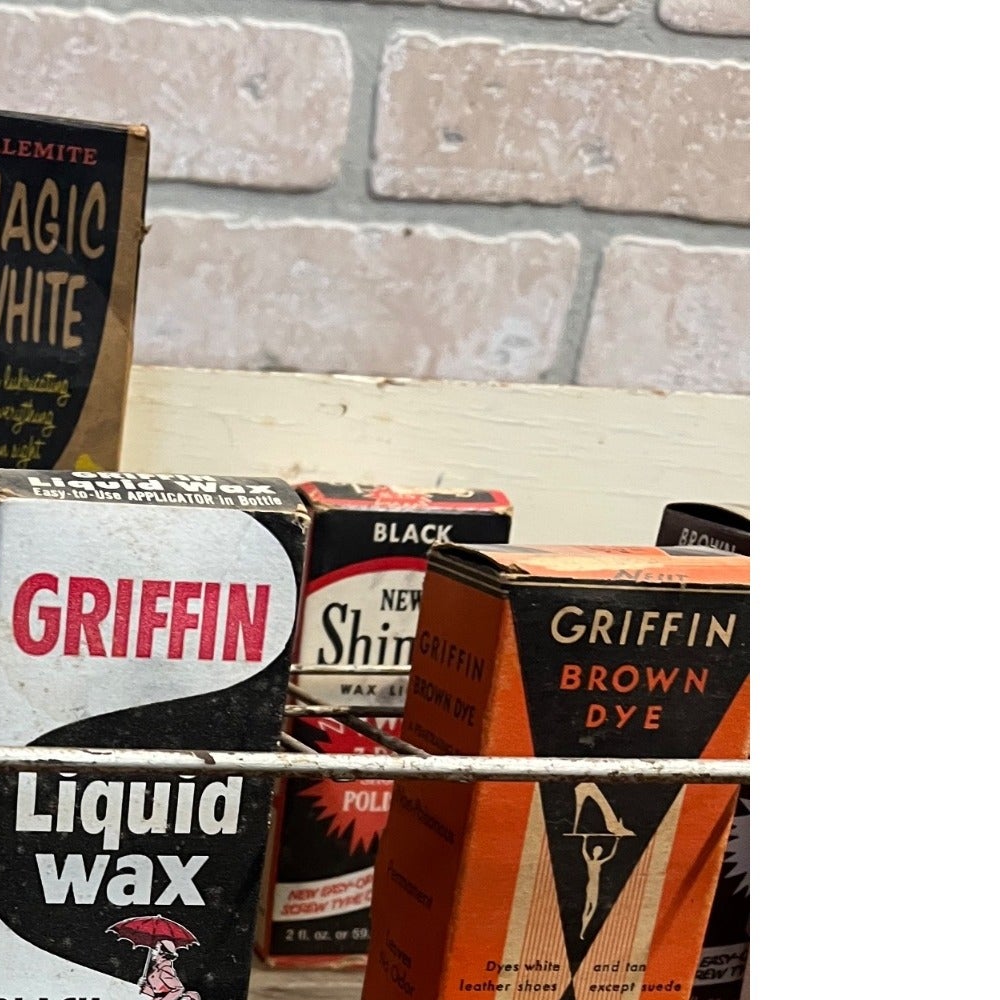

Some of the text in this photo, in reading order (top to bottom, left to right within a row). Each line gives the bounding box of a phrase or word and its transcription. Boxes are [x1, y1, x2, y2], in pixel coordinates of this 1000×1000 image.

[27, 476, 277, 495] Liquid Wax
[32, 487, 283, 507] Easy-to-Use APPLICATOR in Bottle
[372, 522, 453, 545] BLACK
[13, 572, 271, 662] GRIFFIN
[550, 605, 737, 648] GRIFFIN
[419, 630, 485, 682] GRIFFIN
[340, 684, 377, 695] WAX
[559, 664, 710, 693] BROWN
[412, 675, 476, 727] BROWN DYE
[585, 704, 663, 729] DYE
[15, 772, 243, 851] Liquid
[35, 853, 209, 906] wax
[285, 928, 294, 941] 2
[486, 959, 647, 977] Dyes white and tan
[459, 979, 682, 994] leather shoes except suede
